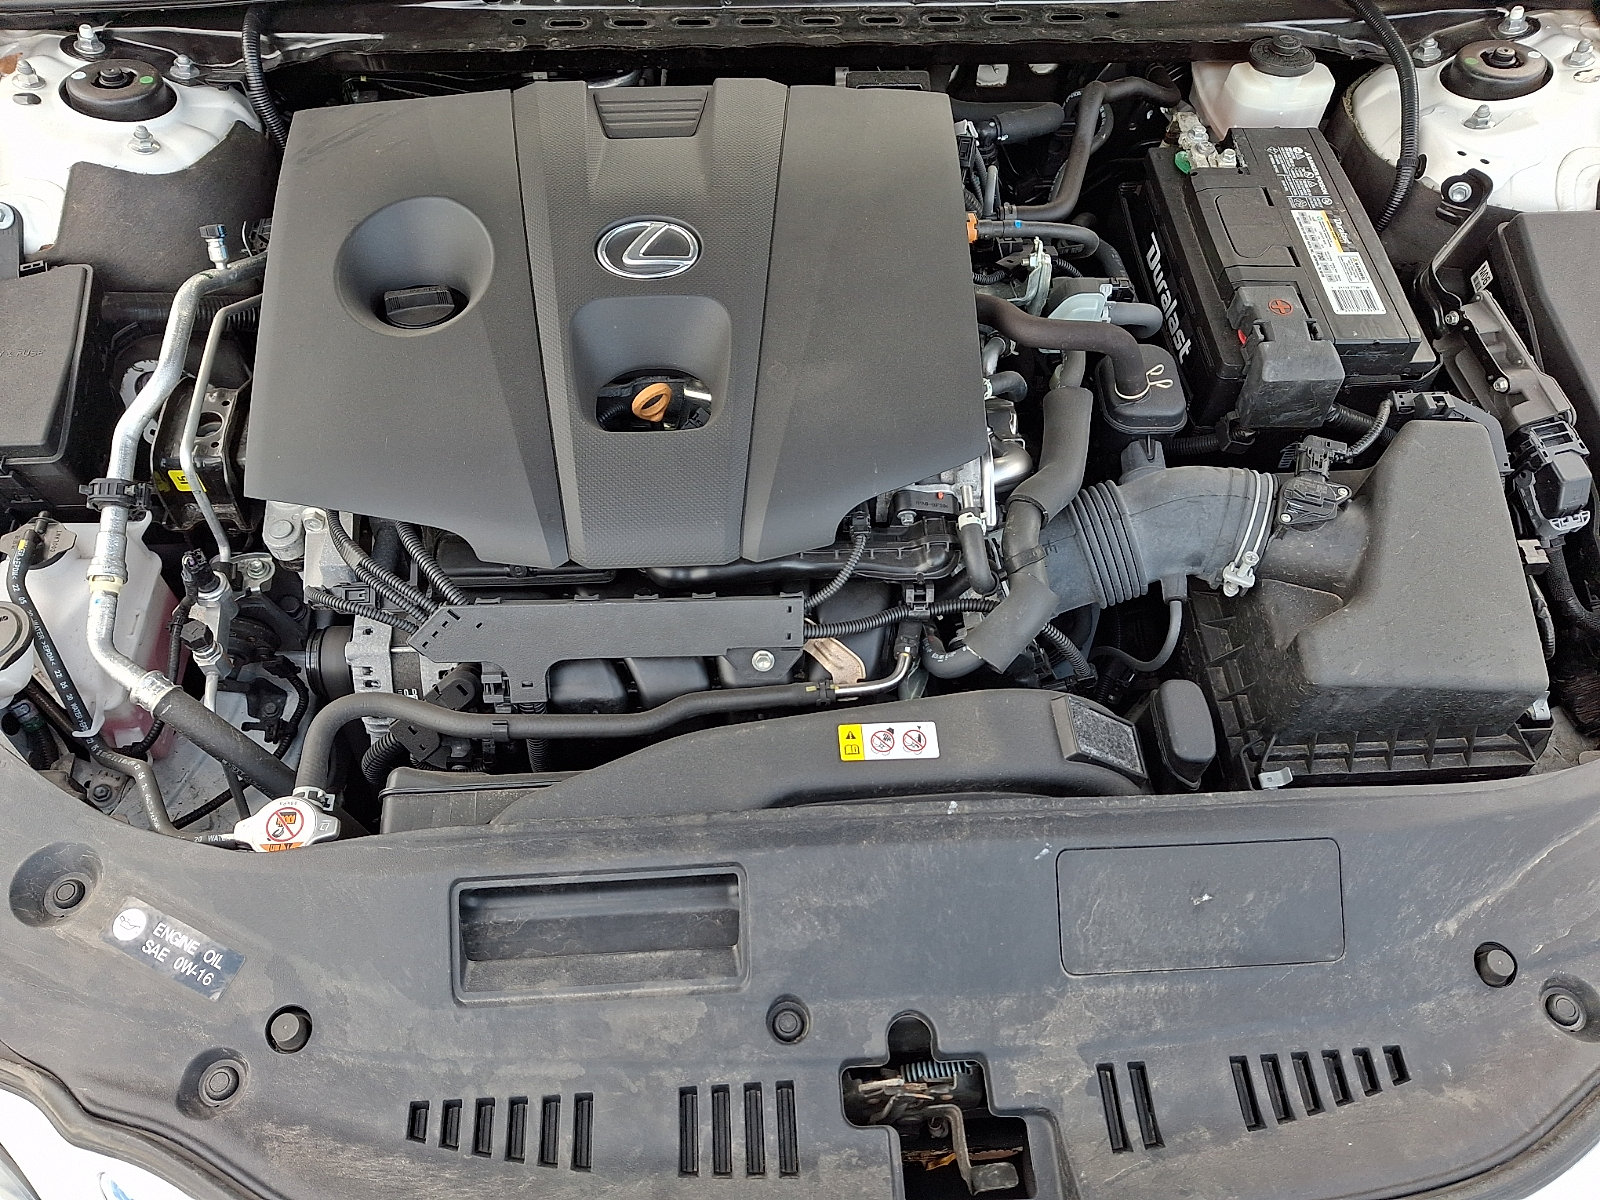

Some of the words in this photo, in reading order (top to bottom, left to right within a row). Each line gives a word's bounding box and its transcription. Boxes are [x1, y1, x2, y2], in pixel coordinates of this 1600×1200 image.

[1146, 232, 1192, 365] Duralast
[141, 939, 171, 963] SAE
[173, 956, 215, 986] 0W-16
[153, 920, 201, 956] ENGINE
[203, 949, 224, 971] OIL
